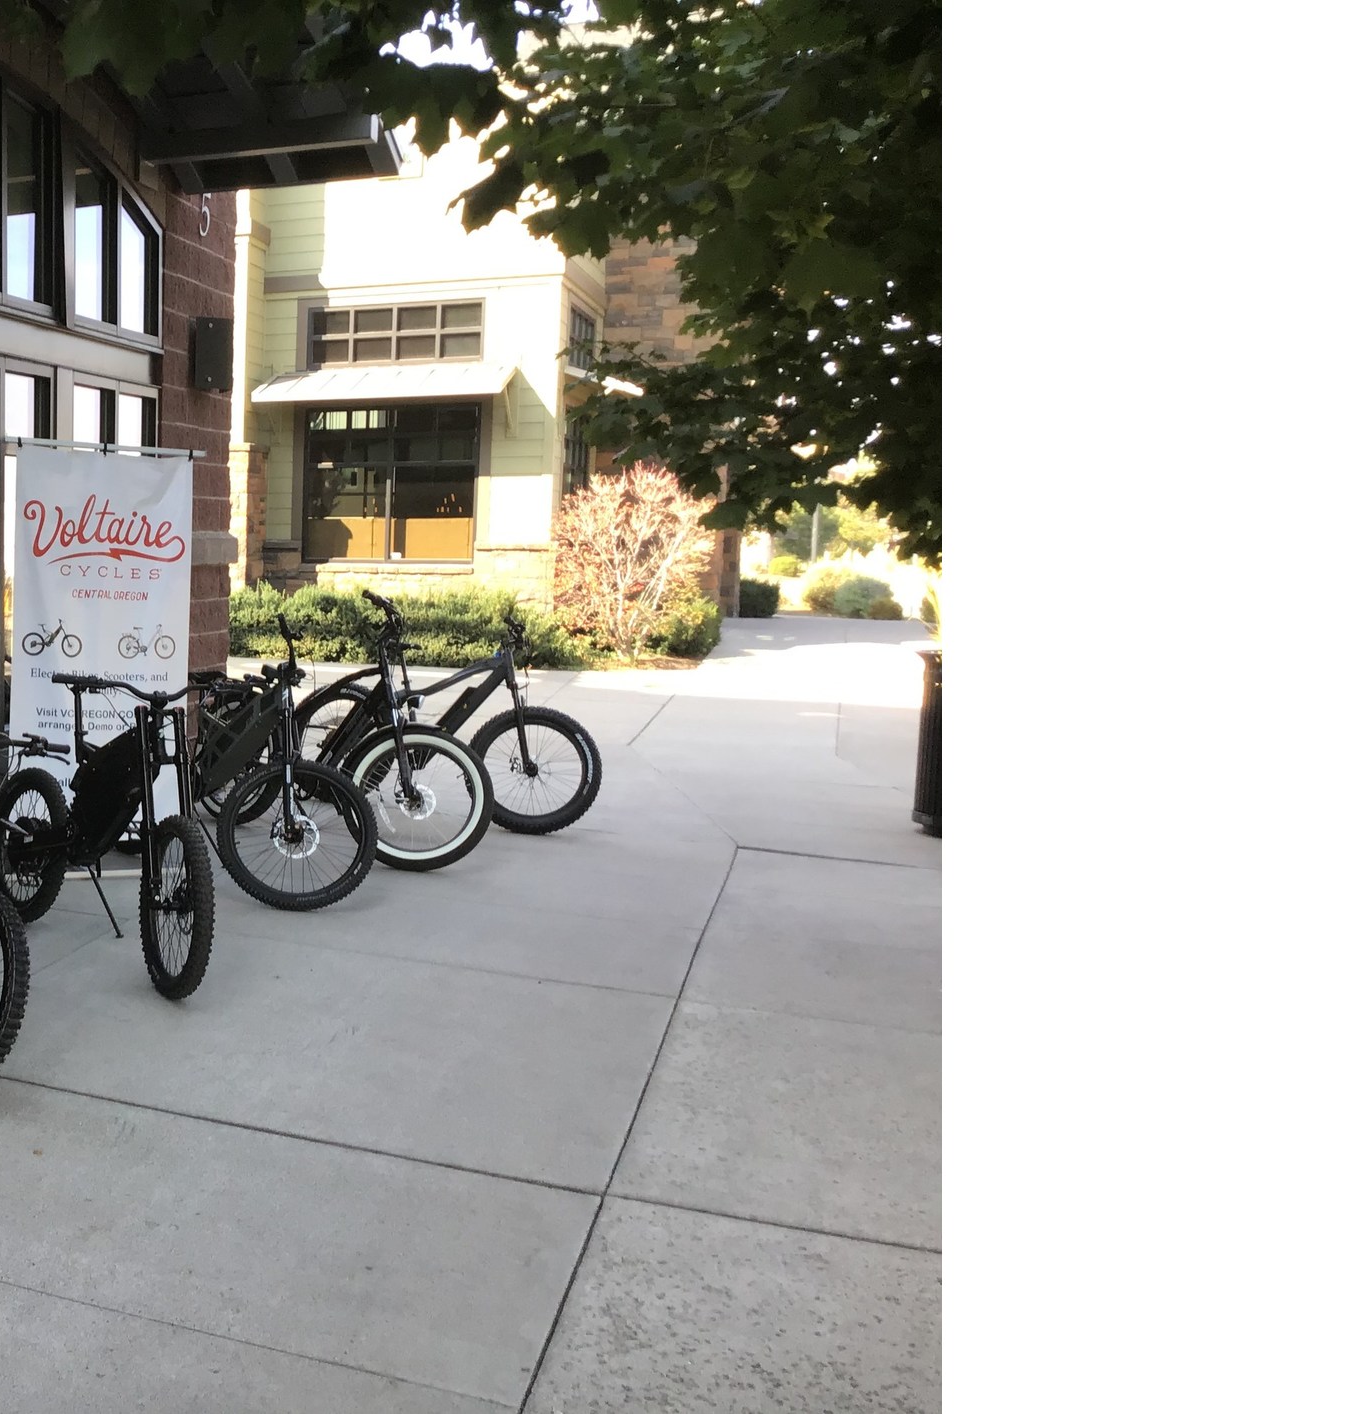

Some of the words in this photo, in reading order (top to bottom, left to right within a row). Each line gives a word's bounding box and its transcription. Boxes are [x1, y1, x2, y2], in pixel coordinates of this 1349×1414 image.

[199, 193, 212, 237] 5
[23, 494, 186, 564] Voltaire
[59, 564, 161, 580] CYCLES
[71, 588, 112, 600] CENTRAL
[113, 590, 149, 601] OREGON
[30, 667, 70, 679] Elect
[103, 670, 148, 682] Scooters,
[150, 671, 168, 681] and
[36, 706, 57, 717] Visit
[87, 721, 113, 731] Demo
[115, 723, 126, 731] or
